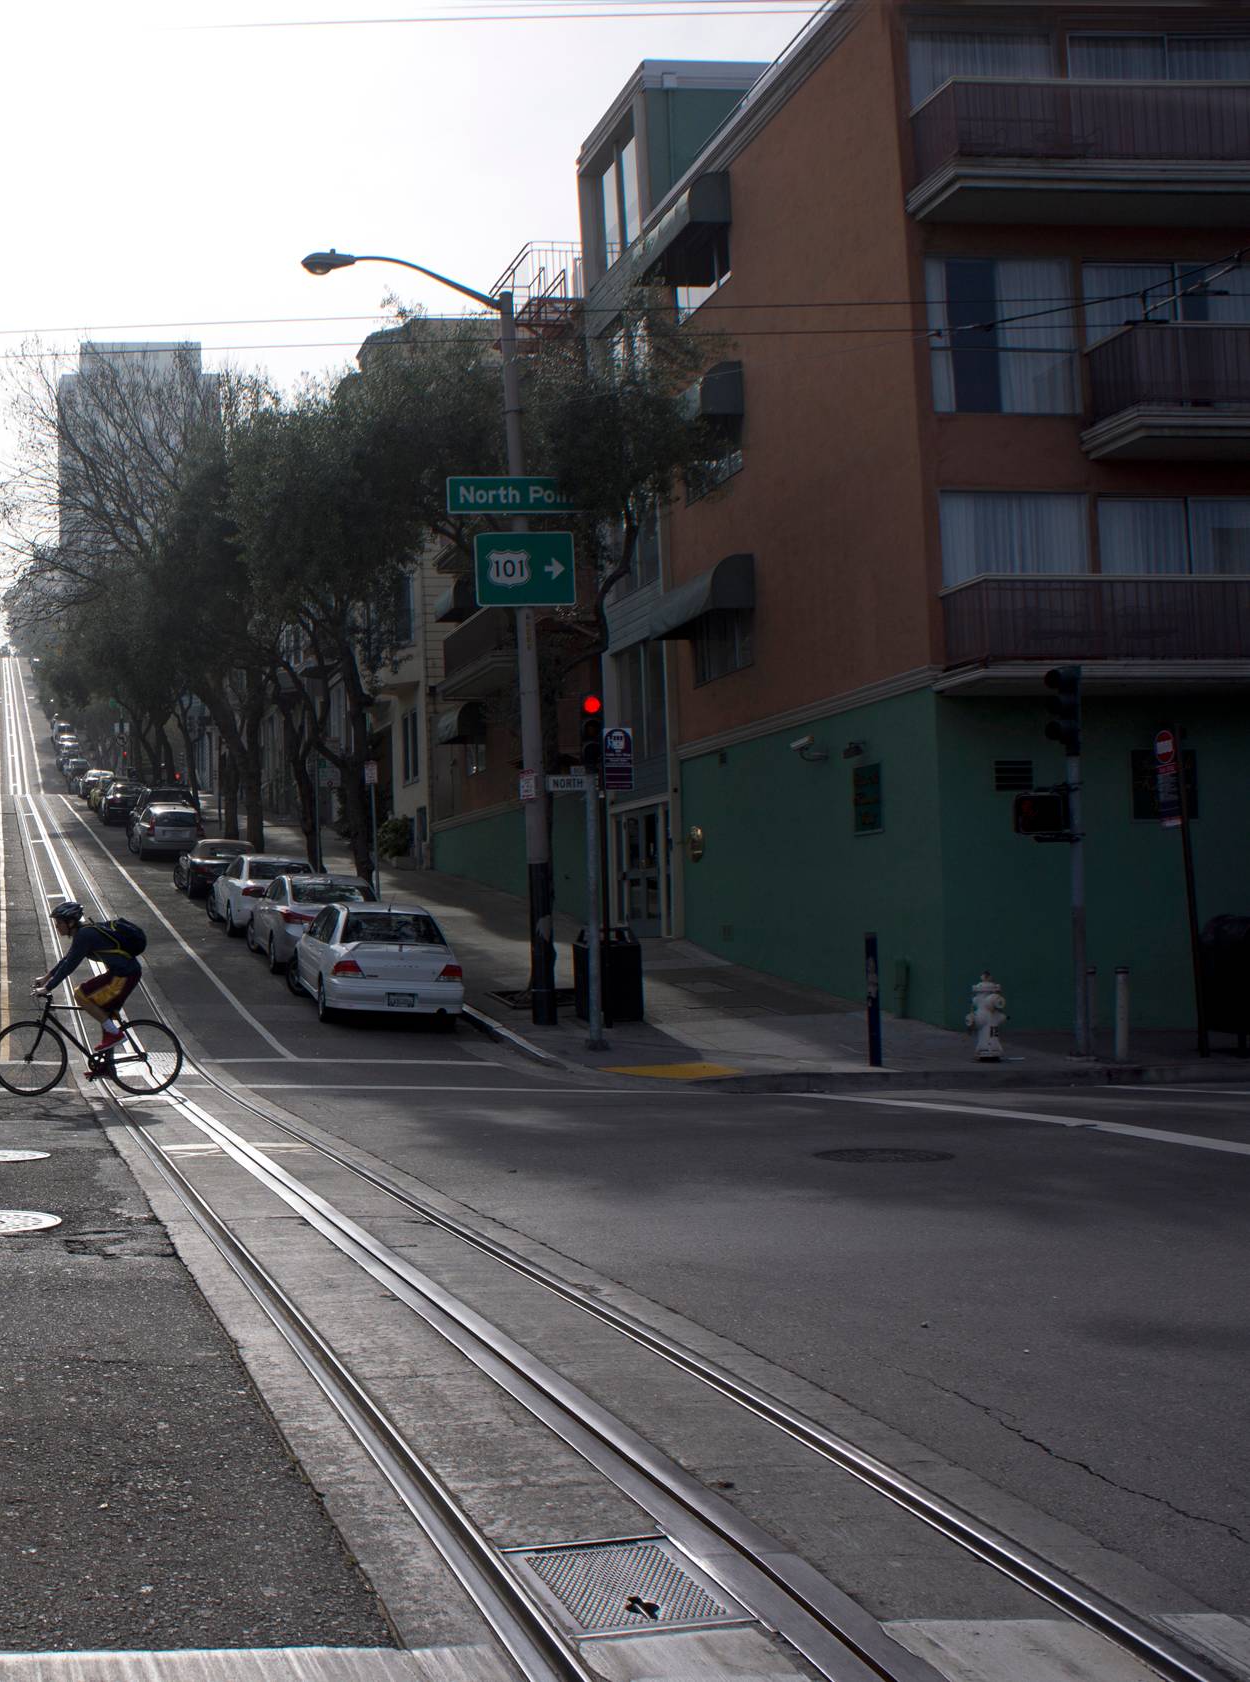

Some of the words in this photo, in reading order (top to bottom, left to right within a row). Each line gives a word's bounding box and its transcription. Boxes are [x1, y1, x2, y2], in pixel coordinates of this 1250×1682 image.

[459, 485, 521, 504] North
[494, 560, 524, 578] 101
[552, 777, 583, 789] NORTH
